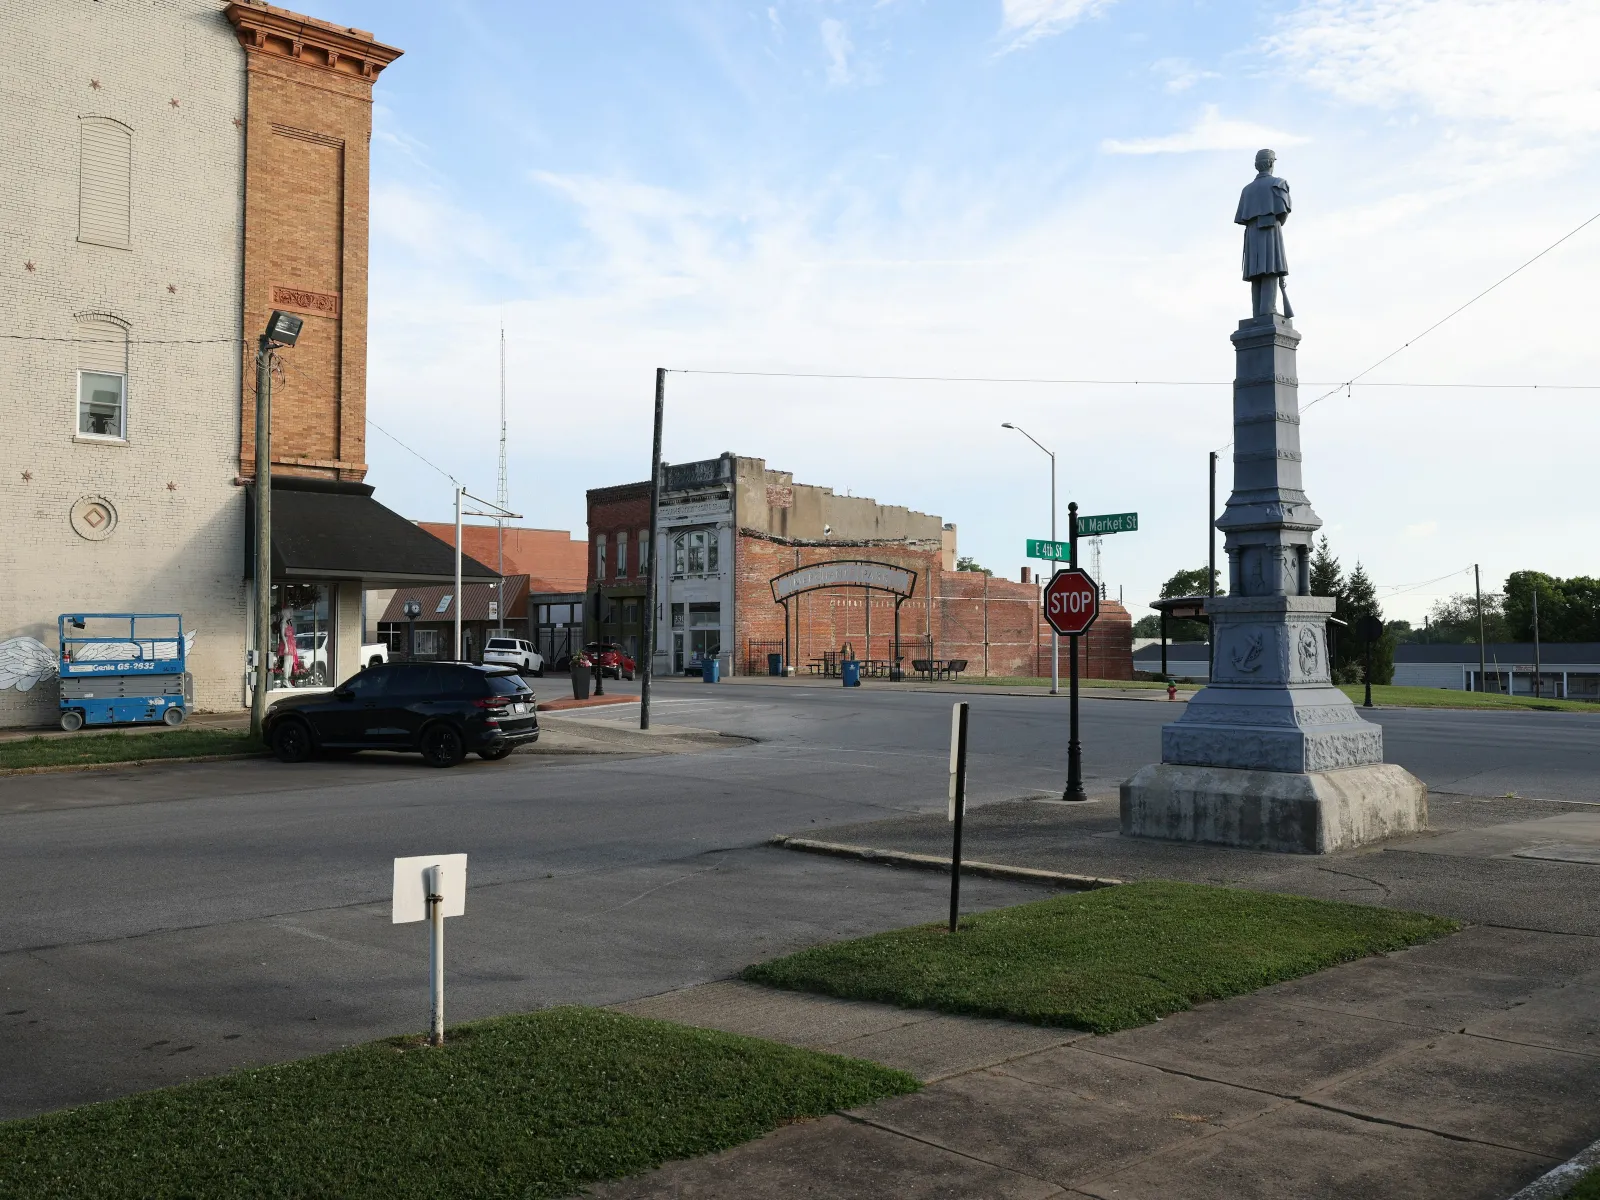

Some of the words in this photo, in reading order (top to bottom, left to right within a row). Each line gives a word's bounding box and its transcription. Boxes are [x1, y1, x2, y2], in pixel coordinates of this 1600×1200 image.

[1078, 519, 1085, 532] N
[1089, 517, 1123, 532] Market
[1126, 516, 1137, 529] St
[1036, 542, 1040, 556] E
[1042, 543, 1054, 557] 4th
[1055, 544, 1063, 558] St
[1050, 591, 1092, 614] STOP
